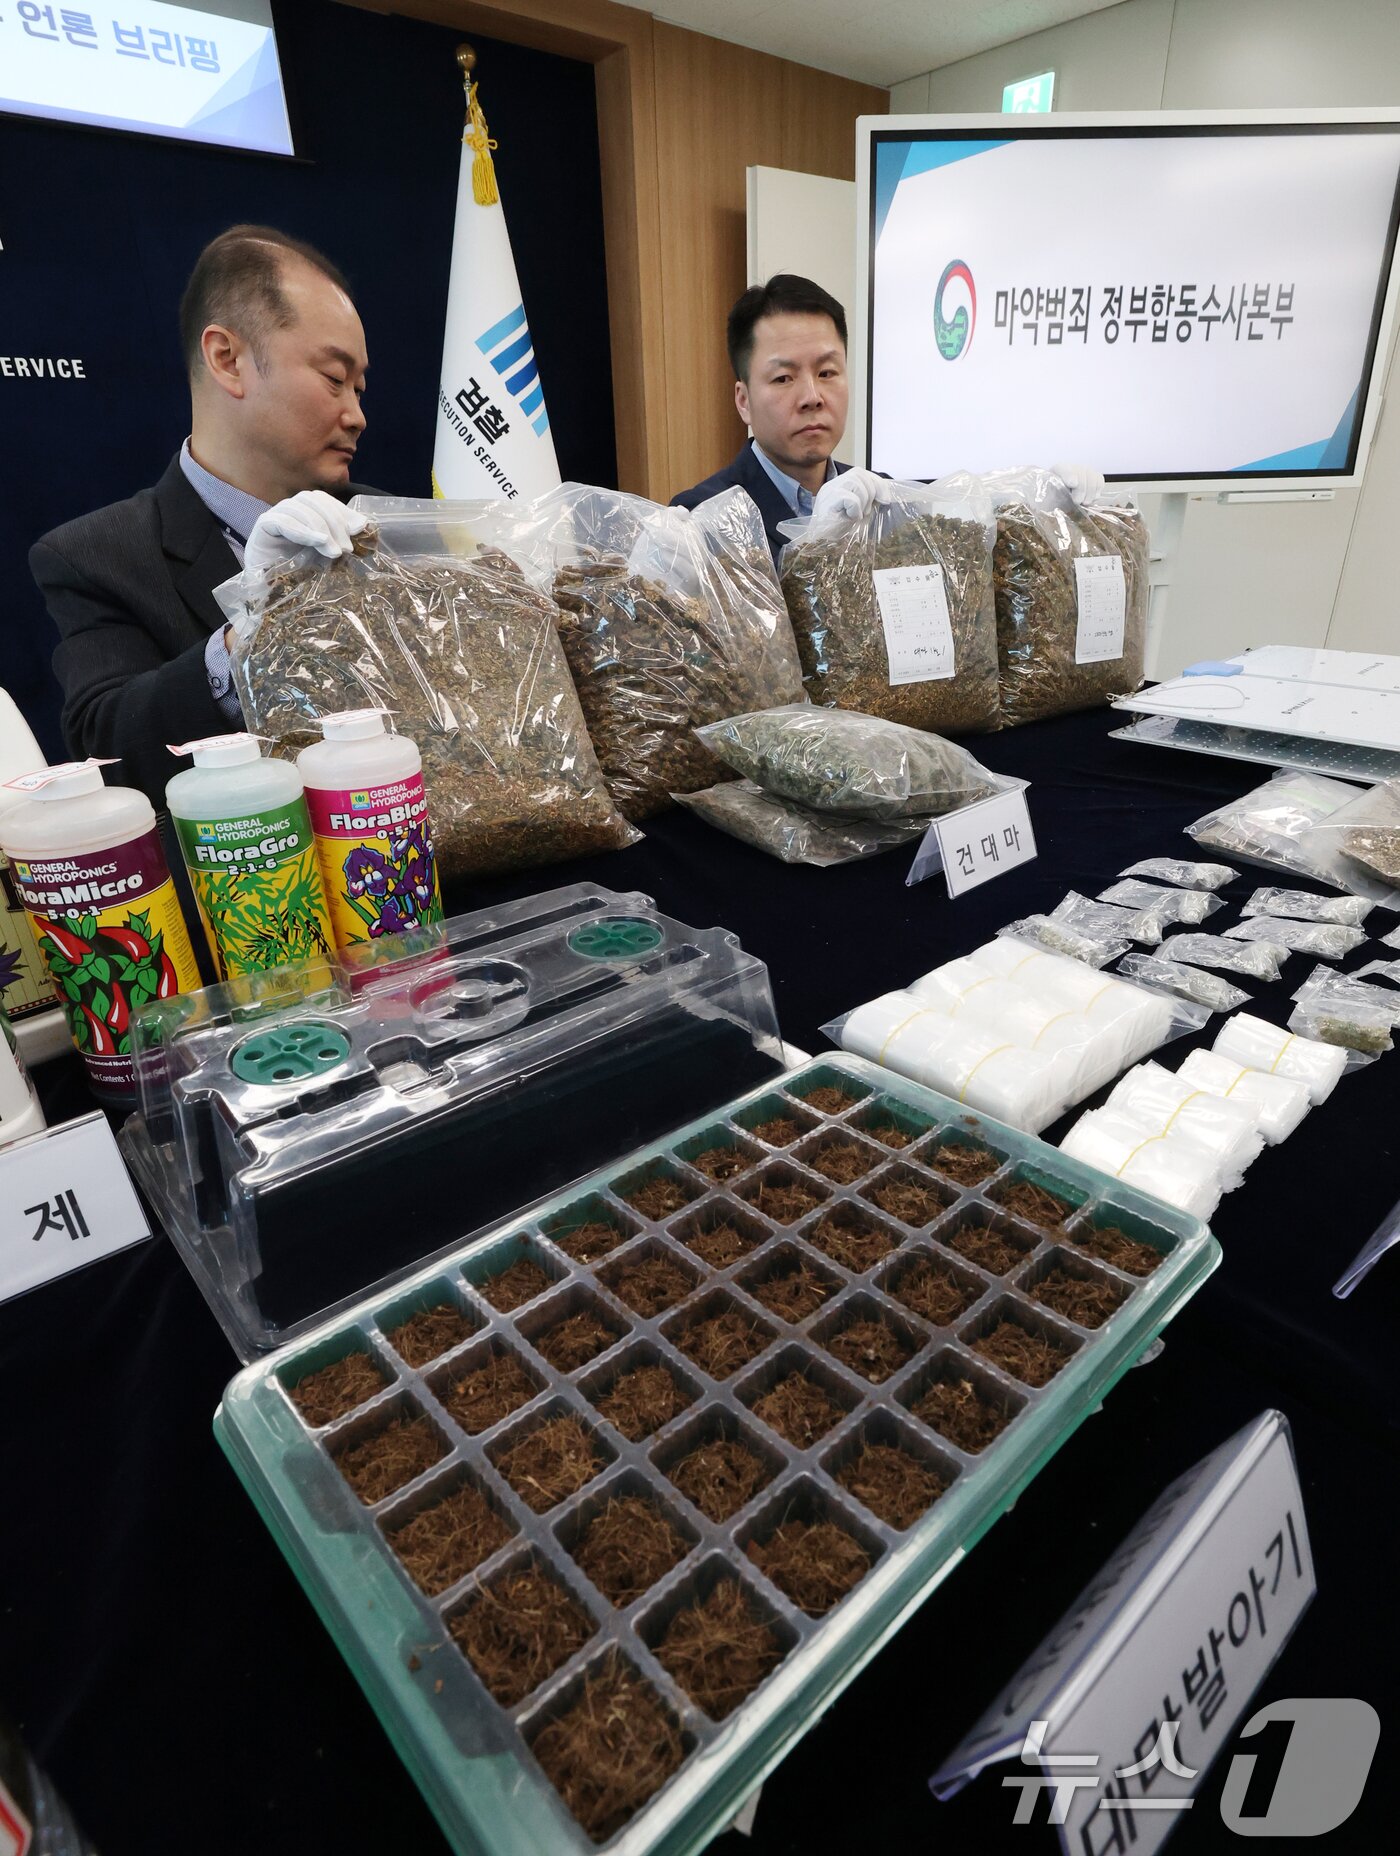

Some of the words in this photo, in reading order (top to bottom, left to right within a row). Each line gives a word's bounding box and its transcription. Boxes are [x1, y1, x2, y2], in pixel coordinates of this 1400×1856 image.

[17, 0, 98, 49] 언론
[112, 20, 220, 73] 브리핑
[994, 286, 1091, 346] 마약범죄
[1100, 283, 1295, 345] 정부합동수사본부
[455, 377, 510, 445] 검찰
[473, 446, 519, 500] SERVICE
[369, 783, 407, 799] GENERAL
[371, 784, 423, 808] HYDROPONICS
[215, 817, 264, 832] GENERAL
[217, 818, 291, 842] HYDROPONICS
[194, 833, 299, 863] FloraGro
[30, 861, 80, 873] GENERAL
[32, 862, 118, 884] HYDROPONICS
[228, 858, 277, 876] 2-1-6
[47, 905, 102, 920] 5-0-1
[24, 1189, 91, 1241] 제
[1080, 1510, 1303, 1856] 대마발아기
